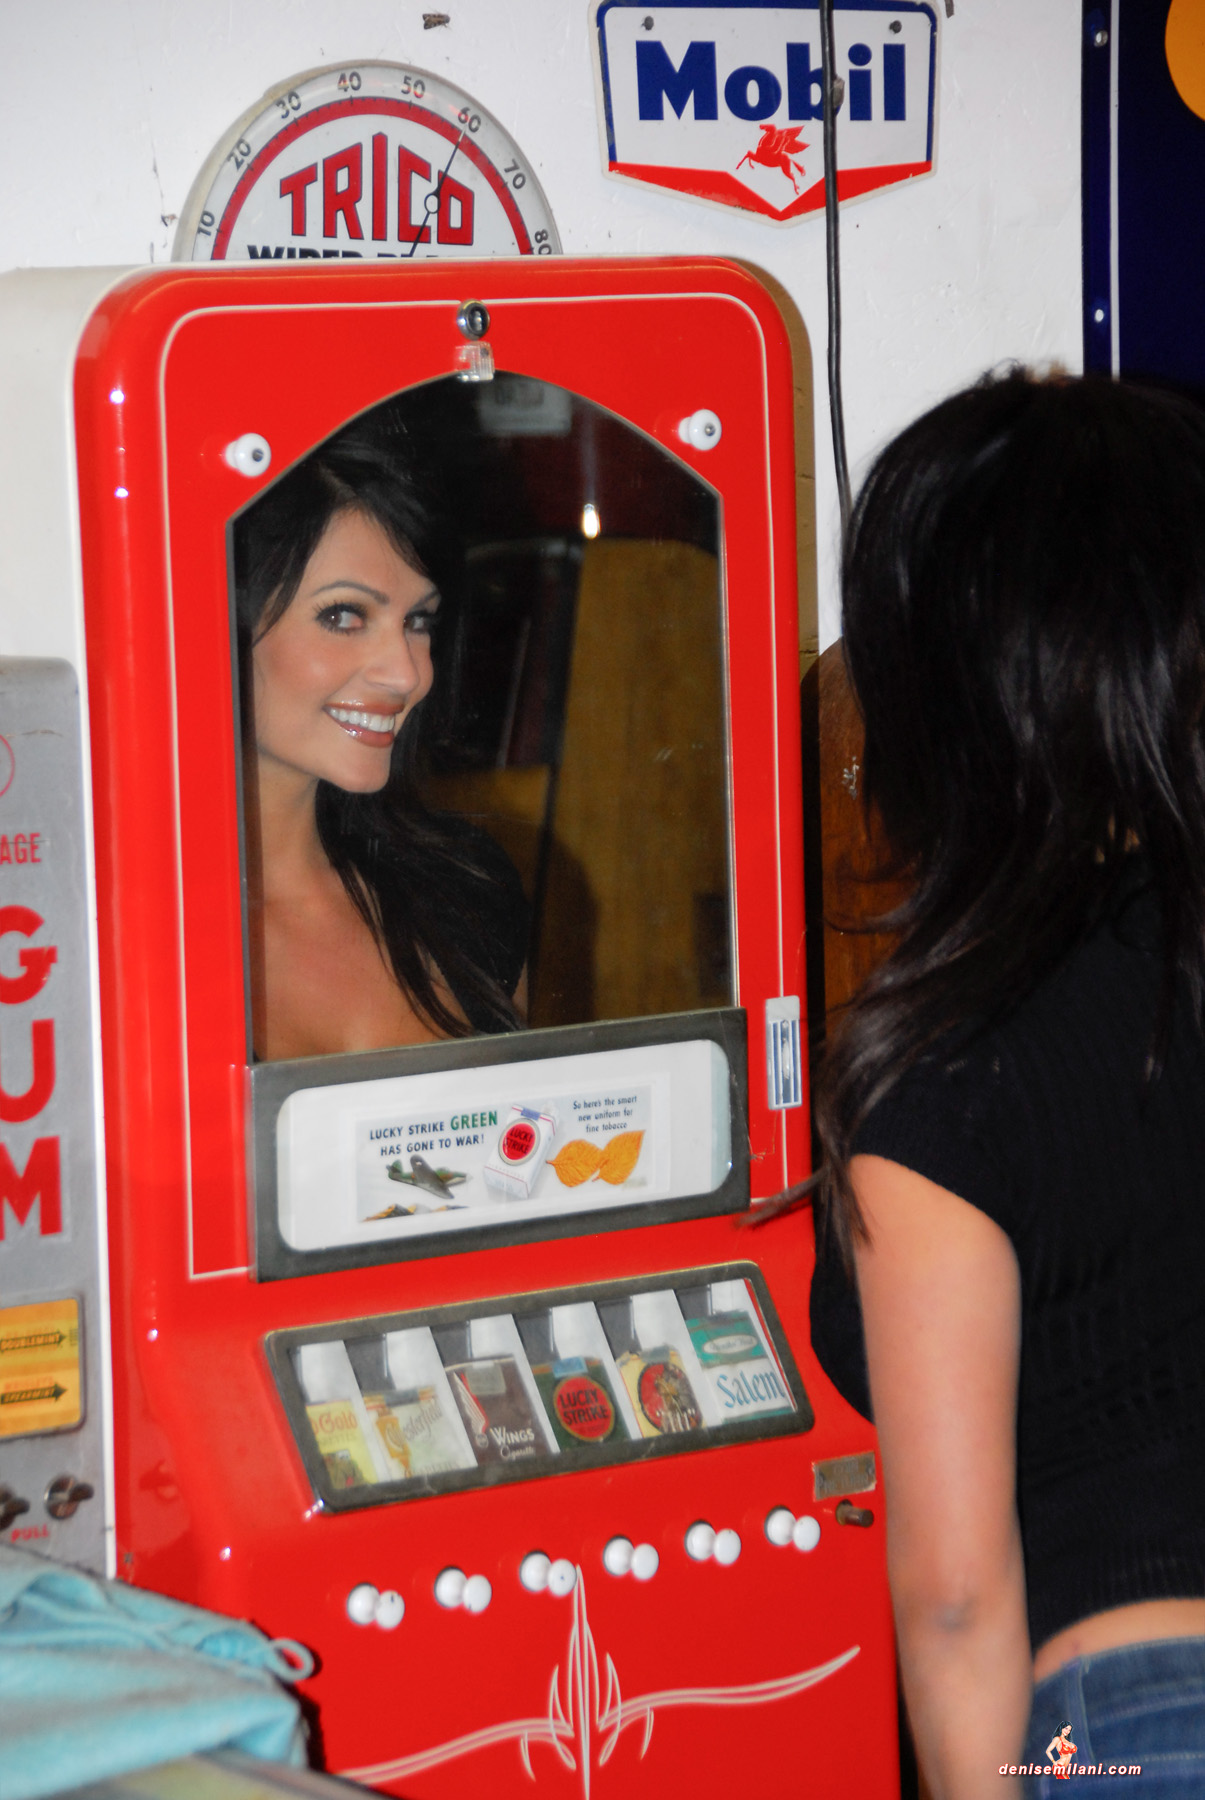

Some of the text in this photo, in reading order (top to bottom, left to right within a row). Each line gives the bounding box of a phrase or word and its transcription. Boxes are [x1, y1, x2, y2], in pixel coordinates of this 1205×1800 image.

[337, 71, 362, 92] 40
[401, 75, 426, 99] 50
[636, 40, 906, 121] Mobil
[275, 91, 302, 119] 30
[457, 107, 481, 133] 60
[227, 138, 252, 171] 20
[504, 158, 526, 190] 70
[279, 131, 475, 246] TRICO
[196, 210, 216, 236] 10
[534, 229, 552, 255] 80
[573, 1101, 582, 1110] So
[604, 1097, 615, 1106] the
[617, 1095, 637, 1105] smart
[370, 1110, 498, 1141] LUCKY STRIKE GREEN
[578, 1114, 592, 1122] new
[594, 1109, 621, 1120] uniform
[585, 1121, 628, 1133] fine tobacco
[380, 1133, 485, 1156] HAS GONE TO WAR!
[504, 1137, 530, 1155] STRIKE
[510, 1127, 534, 1142] LUCKY
[559, 1388, 598, 1409] LUCKY
[716, 1369, 786, 1409] Salem
[563, 1405, 609, 1426] STRIKE
